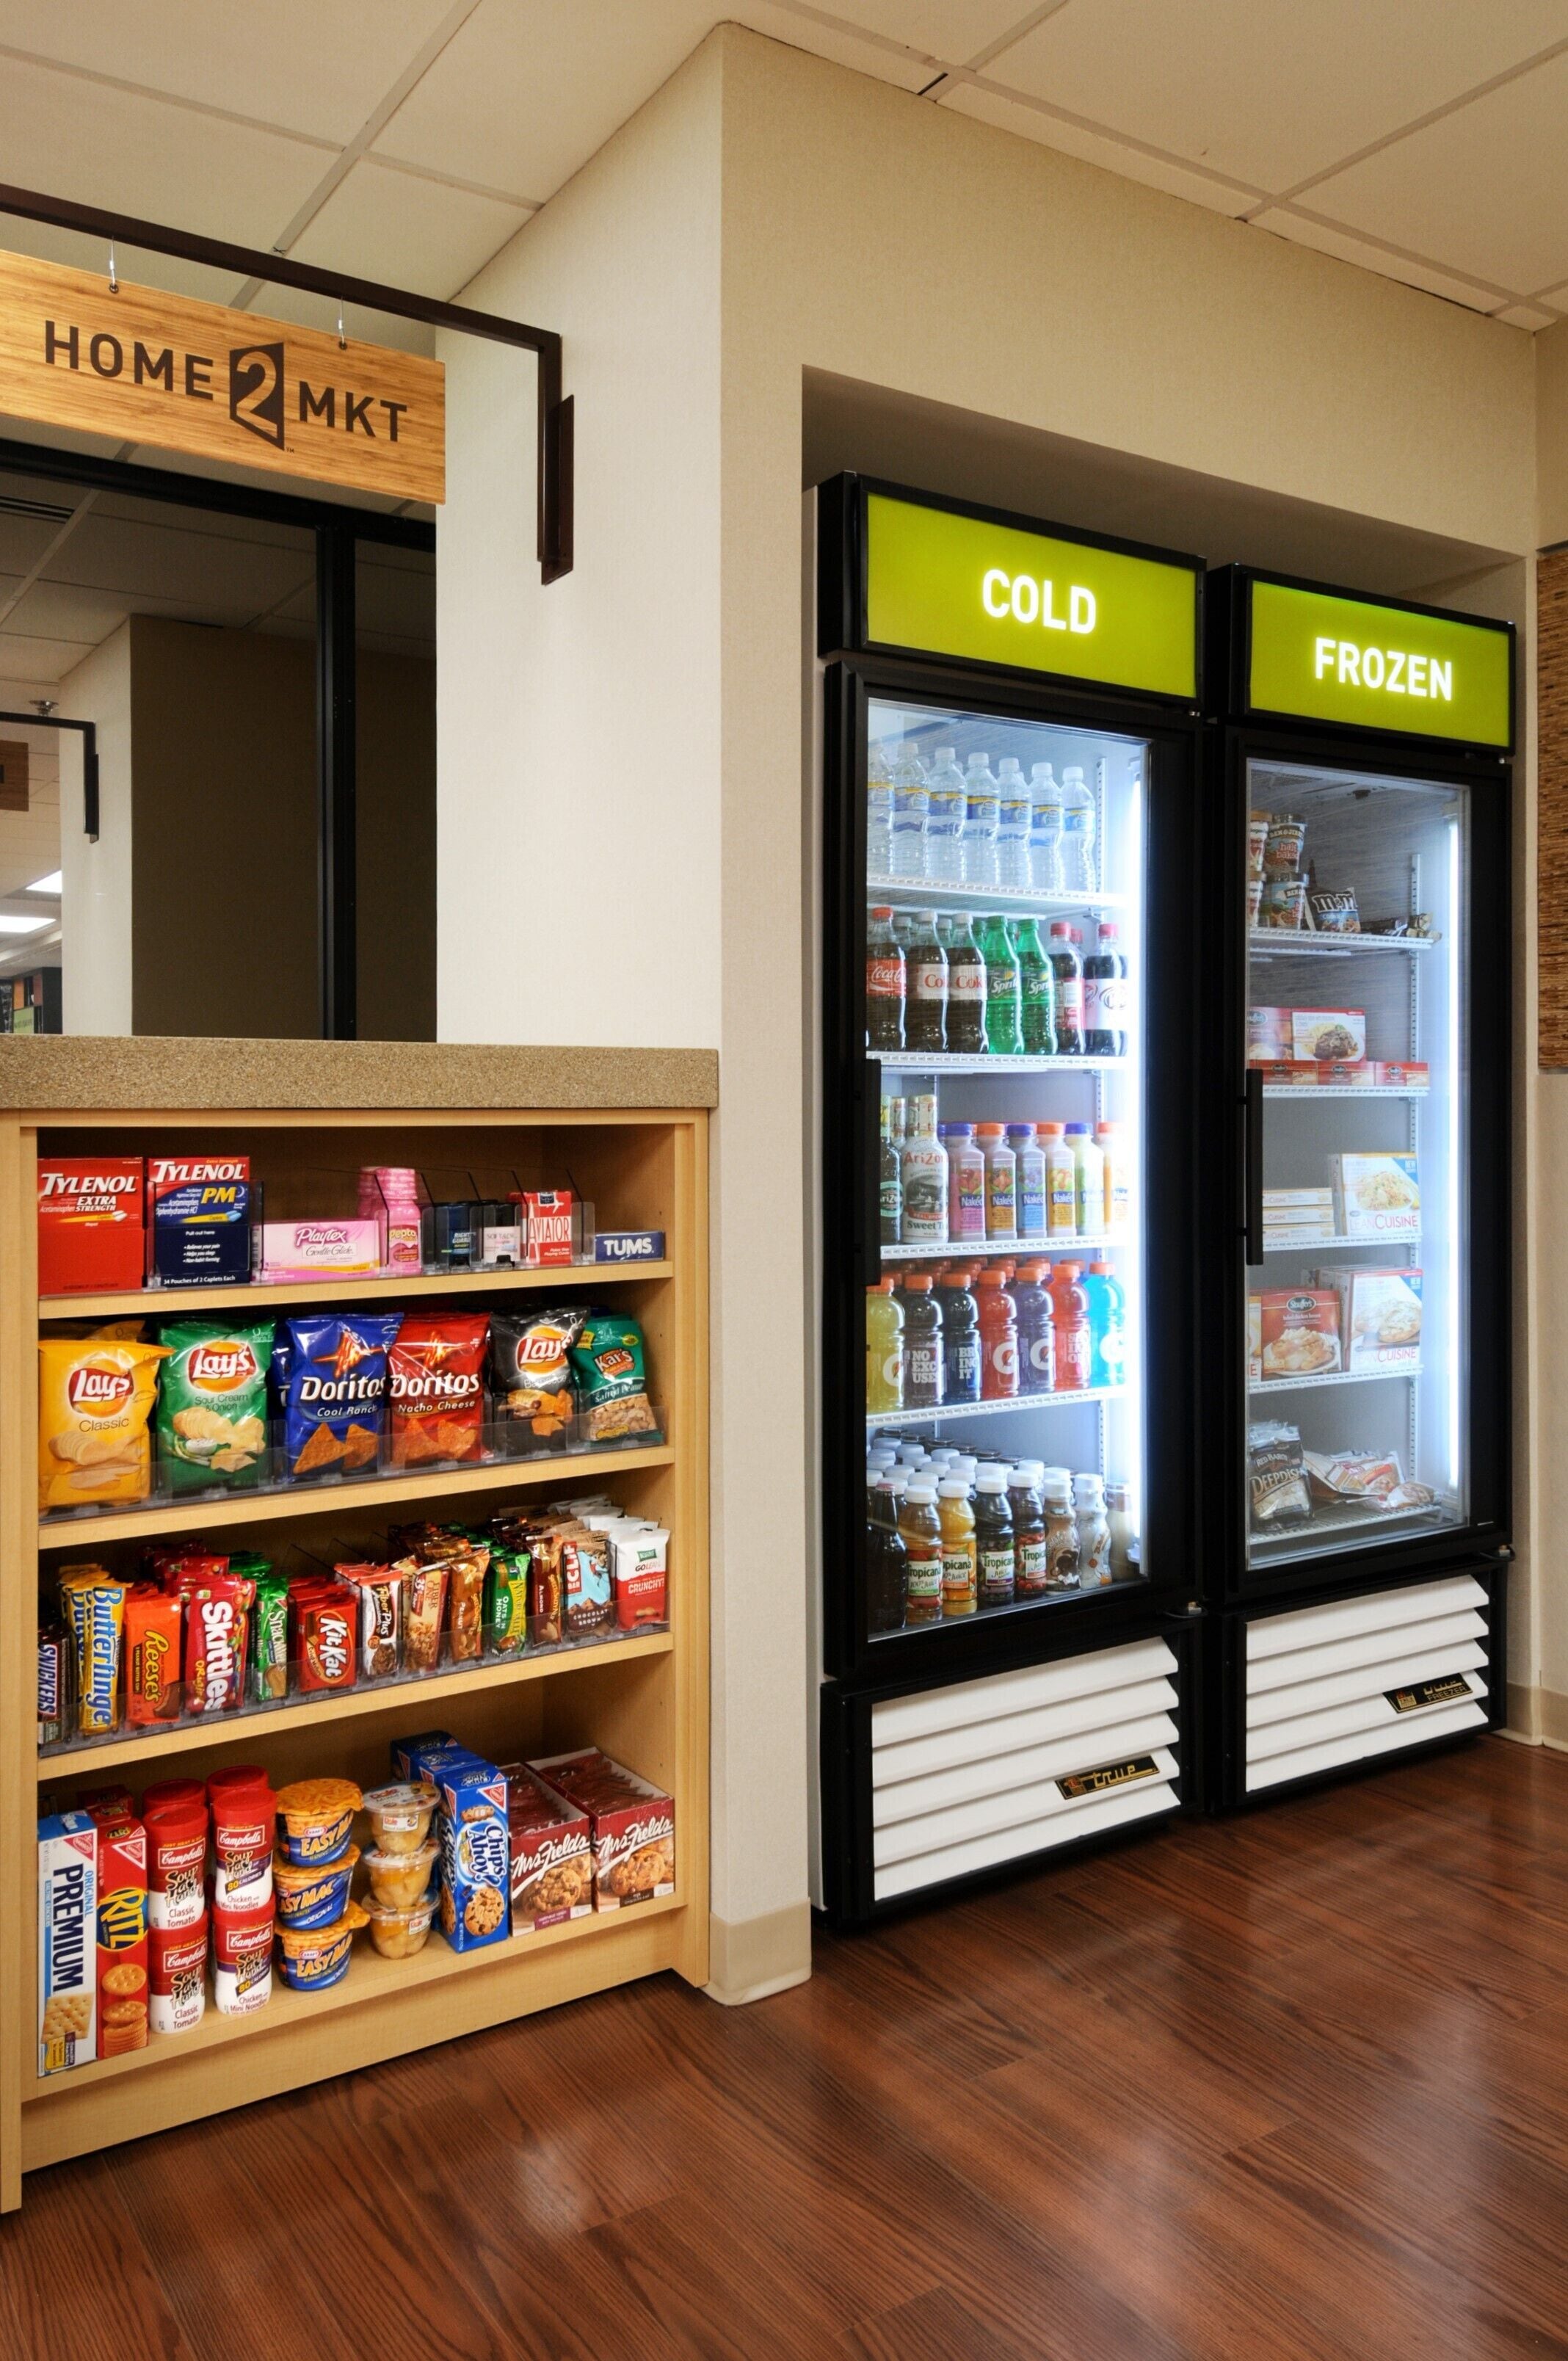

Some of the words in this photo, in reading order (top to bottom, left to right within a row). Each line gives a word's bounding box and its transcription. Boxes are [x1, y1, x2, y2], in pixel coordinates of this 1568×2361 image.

[45, 320, 214, 401] HOME
[299, 381, 407, 442] MKT
[982, 569, 1097, 635] COLD
[1314, 637, 1453, 702] FROZEN
[924, 974, 943, 988] Co
[956, 975, 983, 989] Cok
[152, 1161, 245, 1183] TYLENOL
[40, 1172, 137, 1196] TYLENOL
[76, 1196, 117, 1205] EXTRA
[200, 1186, 236, 1204] PM
[529, 1217, 570, 1241] AVIATOR
[907, 1220, 936, 1229] Sweet
[1375, 1214, 1418, 1229] CUISINE
[297, 1227, 346, 1247] Playtex
[603, 1237, 653, 1255] TUMS
[305, 1246, 331, 1257] Gentle
[595, 1348, 633, 1371] Kar's
[912, 1350, 930, 1360] NO
[912, 1372, 938, 1383] USE
[959, 1369, 973, 1379] IT
[390, 1369, 479, 1399] Doritos
[194, 1396, 217, 1405] Sour
[218, 1394, 249, 1404] Cream
[211, 1403, 238, 1411] Onion
[397, 1403, 433, 1413] Nacho
[438, 1399, 476, 1410] Cheese
[316, 1407, 343, 1417] Cool
[79, 1417, 129, 1432] Classic
[981, 1555, 1014, 1569] Tropican
[907, 1564, 941, 1579] Tropicana
[567, 1581, 581, 1590] BAR
[431, 1582, 440, 1609] FIBER
[457, 1602, 466, 1630] PEANUT
[501, 1595, 509, 1620] OATS
[573, 1609, 609, 1620] CHOCOLAT
[86, 1586, 123, 1726] Butterfinge
[202, 1600, 233, 1711] Skittles
[144, 1630, 170, 1702] Reese's
[37, 1644, 58, 1715] SNICKERS
[1428, 1686, 1467, 1702] FREEZER
[1093, 1764, 1136, 1788] true
[219, 1830, 261, 1848] Campbell's
[301, 1827, 338, 1857] EASY
[624, 1815, 673, 1863] Fields
[225, 1850, 254, 1867] Soup
[485, 1824, 506, 1878] Chips
[538, 1832, 590, 1881] Fields
[165, 1865, 198, 1890] Soup
[228, 1879, 239, 1891] 80
[84, 1870, 95, 1918] ORIGINAL
[228, 1894, 253, 1903] Chicken
[280, 1895, 301, 1913] ASY
[301, 1879, 338, 1910] MAC
[169, 1905, 195, 1918] Classic
[233, 1901, 259, 1910] Noodles
[52, 1863, 84, 1992] PREMIUM
[98, 1888, 145, 1949] RITZ
[167, 1915, 195, 1928] Tomato
[236, 1947, 264, 1969] Soup
[297, 1951, 334, 1978] EASY
[170, 1965, 202, 1992] Soup
[239, 1980, 250, 1993] 80
[239, 1992, 263, 2004] Chicken
[175, 2004, 199, 2019] Classic
[230, 2004, 244, 2012] Mini
[173, 2014, 199, 2029] Tomato
